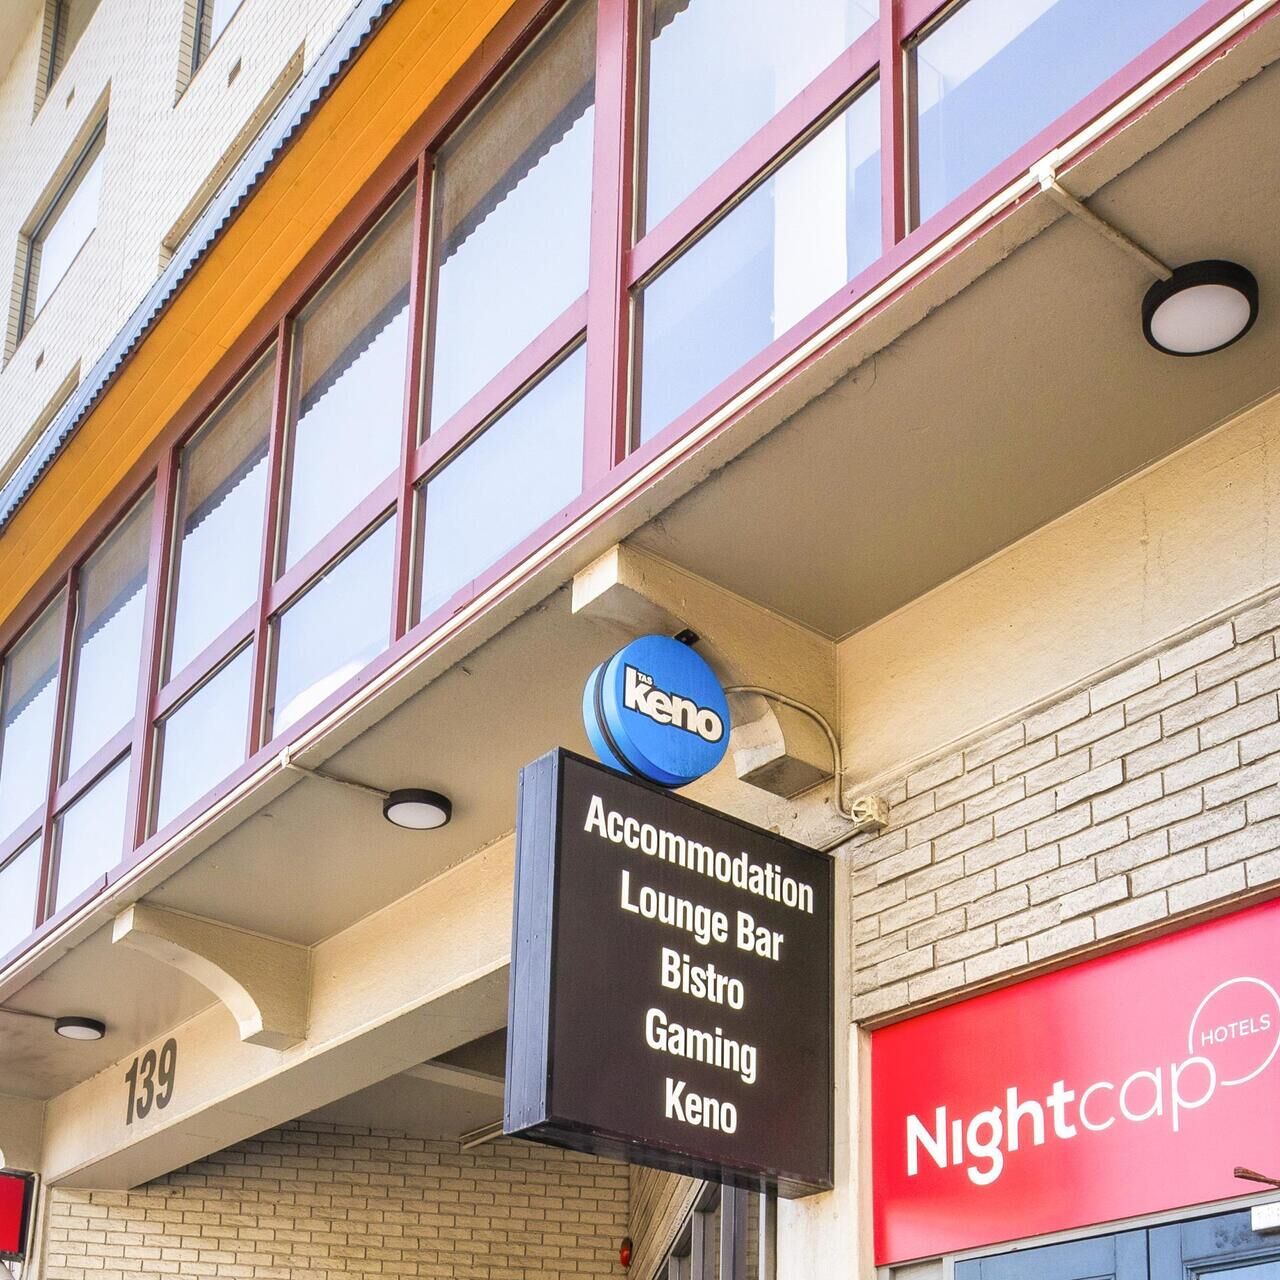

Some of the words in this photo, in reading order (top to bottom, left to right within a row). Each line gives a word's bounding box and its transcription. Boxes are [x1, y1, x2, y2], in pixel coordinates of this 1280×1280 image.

[637, 671, 653, 685] TAS
[583, 795, 815, 914] Accommodation
[620, 871, 728, 944] Lounge
[736, 923, 784, 961] Bar
[661, 948, 745, 1010] Bistro
[645, 1008, 758, 1083] Gaming
[1201, 1013, 1272, 1047] HOTELS
[124, 1038, 178, 1126] 139
[665, 1078, 737, 1135] Keno
[906, 1056, 1217, 1186] Nightcap
